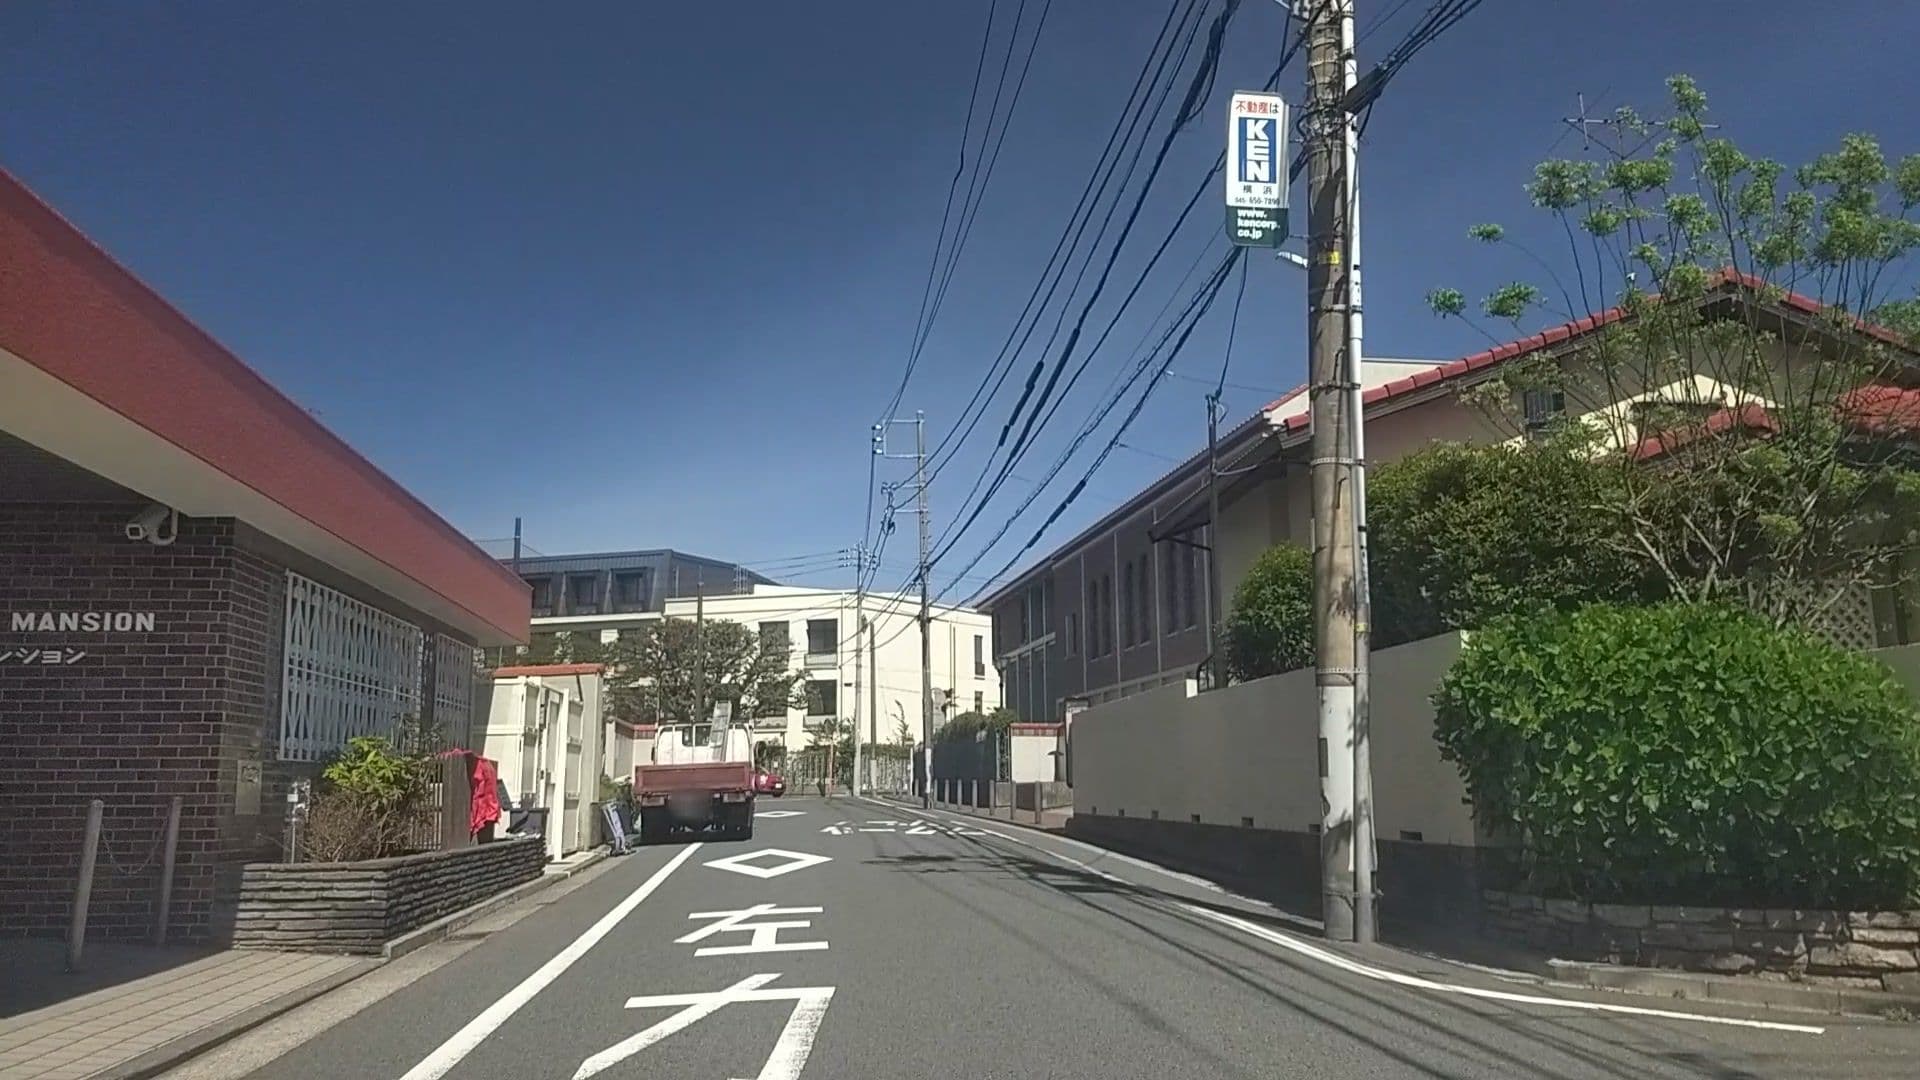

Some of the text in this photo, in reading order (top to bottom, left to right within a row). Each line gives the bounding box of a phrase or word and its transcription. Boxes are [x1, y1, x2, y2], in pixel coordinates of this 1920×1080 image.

[1235, 100, 1280, 114] 不動産は
[1246, 119, 1270, 181] KEN
[1237, 209, 1268, 218] www.
[1237, 228, 1263, 240] co.jp
[11, 611, 155, 632] MANSION
